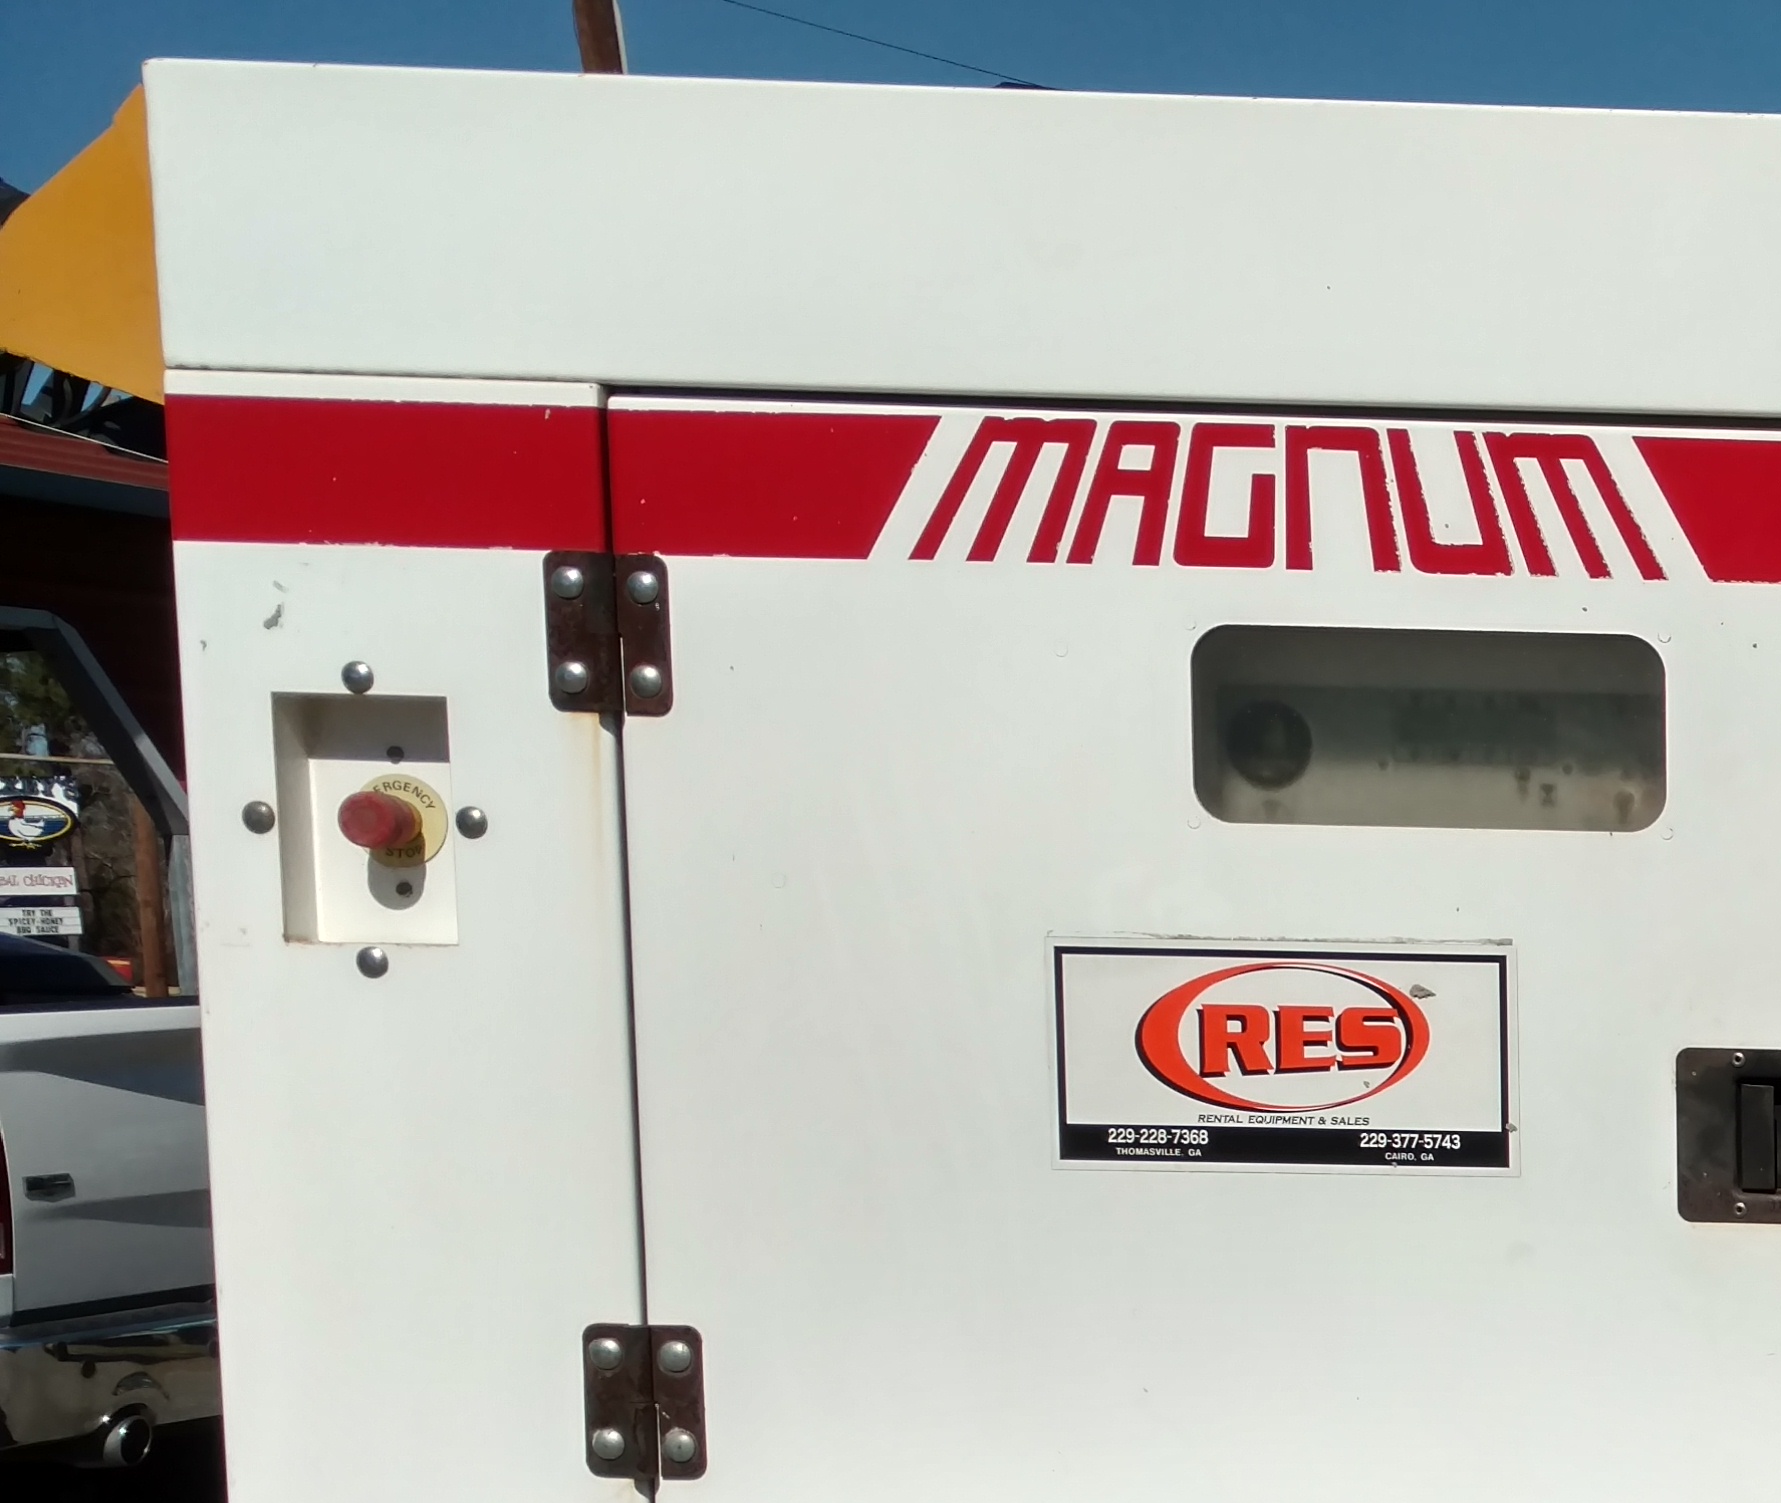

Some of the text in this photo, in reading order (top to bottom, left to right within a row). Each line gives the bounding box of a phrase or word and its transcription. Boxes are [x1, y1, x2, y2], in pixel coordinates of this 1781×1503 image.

[908, 414, 1670, 583] MAGNUM
[373, 780, 436, 810] ERGENCY
[22, 909, 53, 917] TRY THE
[1197, 1002, 1403, 1079] RES
[1198, 1114, 1370, 1126] RENTAL EQUIPMENT & SALES
[1107, 1127, 1209, 1145] 229-228-7368
[1359, 1132, 1461, 1150] 229-377-5743
[1188, 1148, 1202, 1157] GA
[1420, 1152, 1435, 1161] GA
